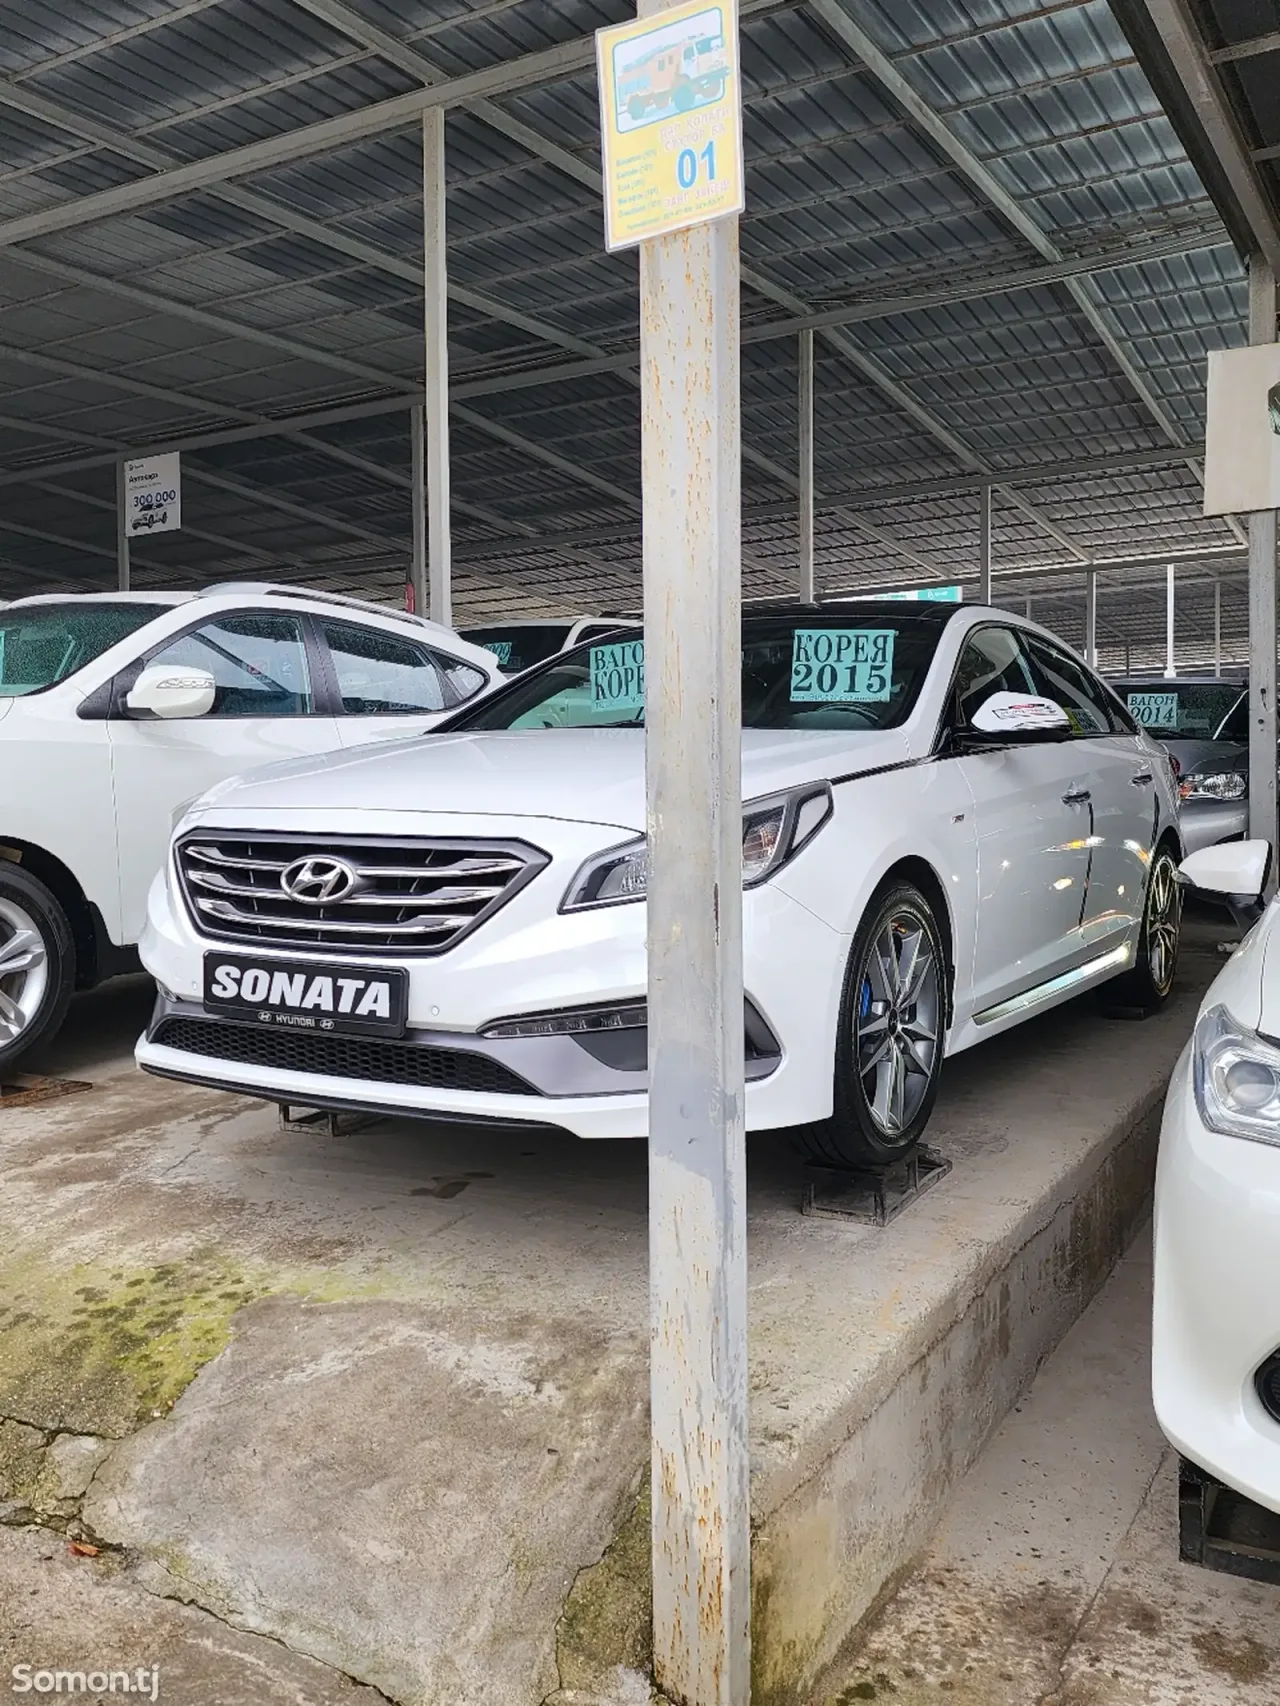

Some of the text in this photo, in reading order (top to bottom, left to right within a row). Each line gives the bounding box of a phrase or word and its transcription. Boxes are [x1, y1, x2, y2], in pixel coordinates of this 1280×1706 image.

[677, 140, 715, 189] 01
[594, 642, 645, 671] ВАГО
[794, 633, 889, 664] КОРЕЯ
[594, 664, 645, 701] КОРЕ
[792, 663, 887, 694] 2015
[1129, 695, 1174, 706] ВАГОН
[211, 964, 391, 1018] SONATA
[275, 1013, 316, 1028] HYUNDAI
